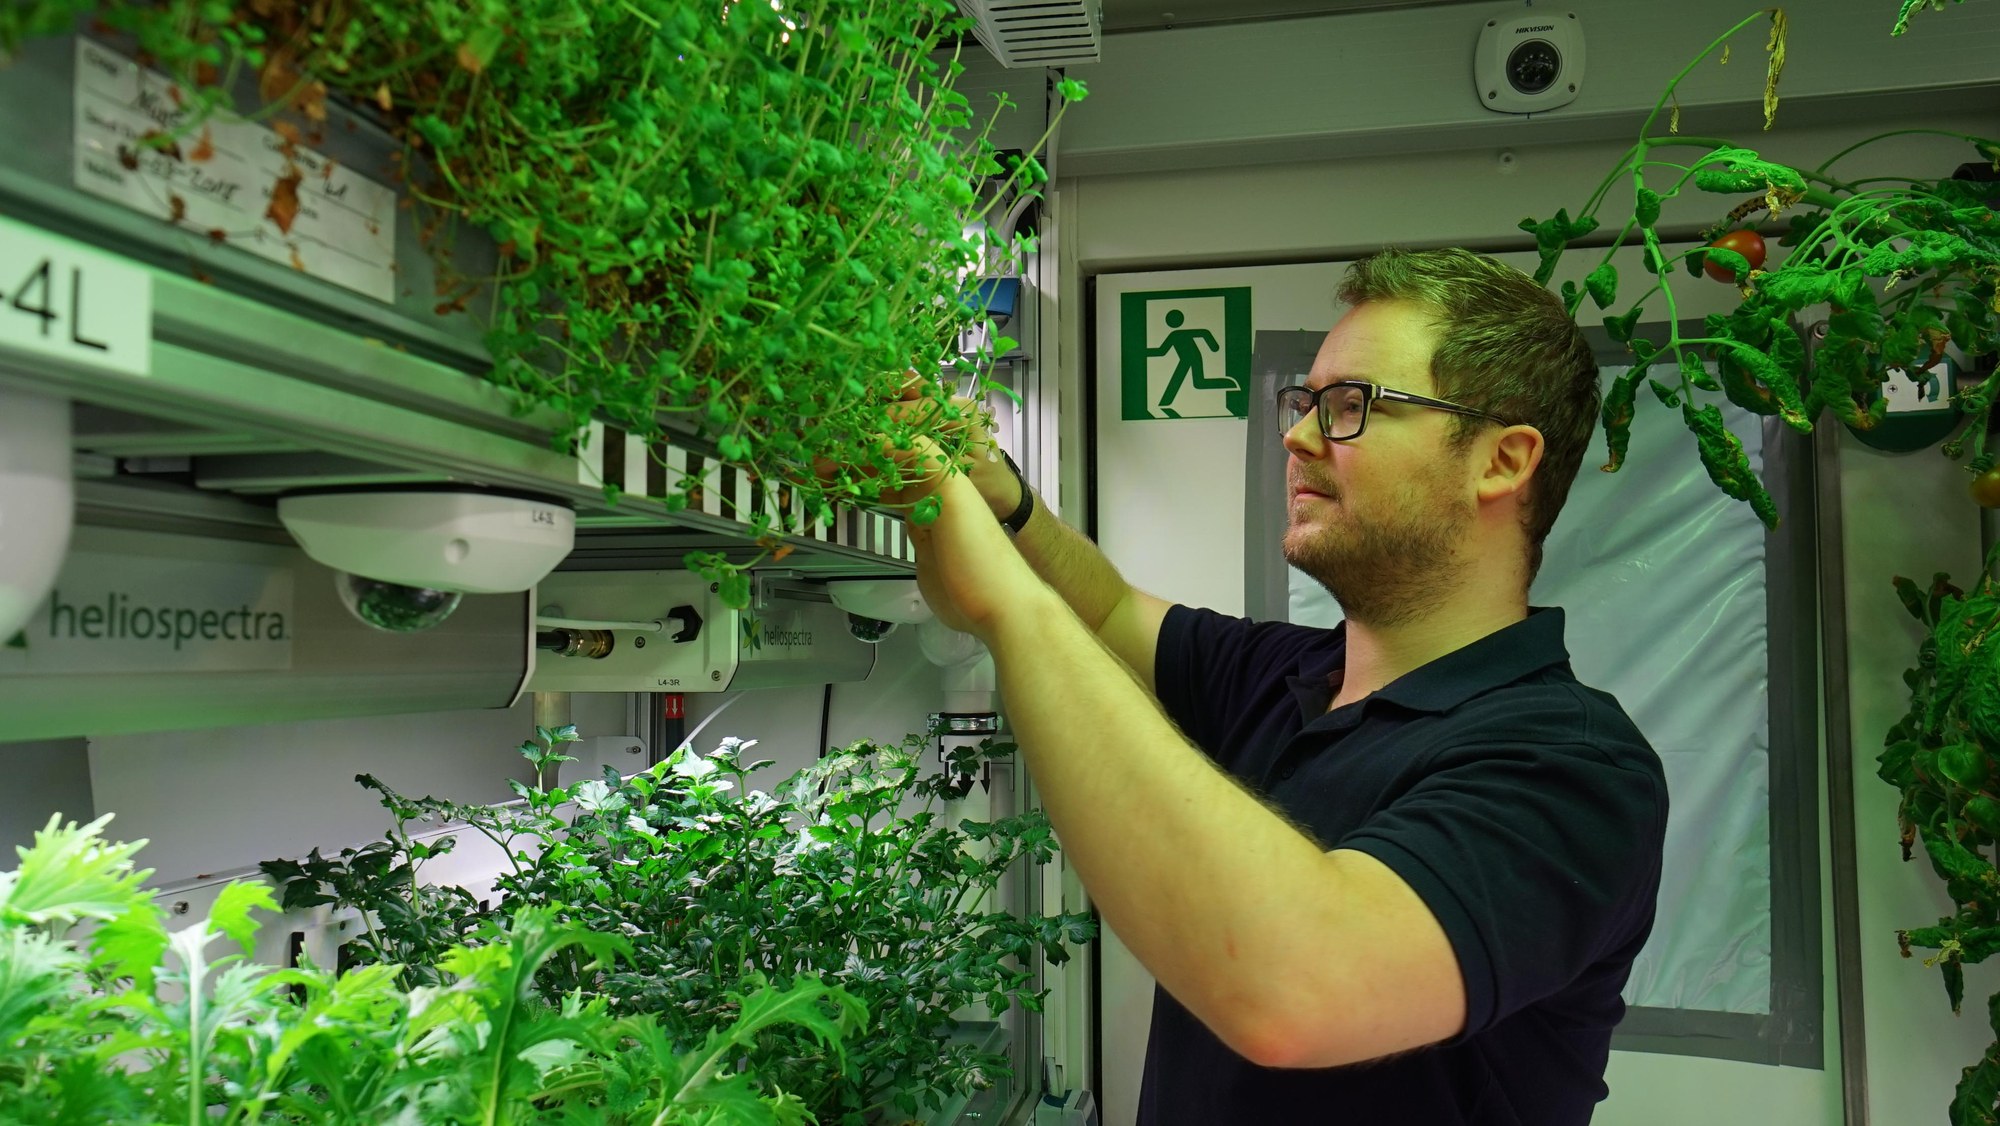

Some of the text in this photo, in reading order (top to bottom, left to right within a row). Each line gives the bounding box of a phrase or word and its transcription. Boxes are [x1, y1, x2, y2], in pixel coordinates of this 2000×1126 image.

[1515, 25, 1554, 34] HIKVISION
[764, 624, 812, 651] heliospectra
[657, 678, 680, 686] L4-3R
